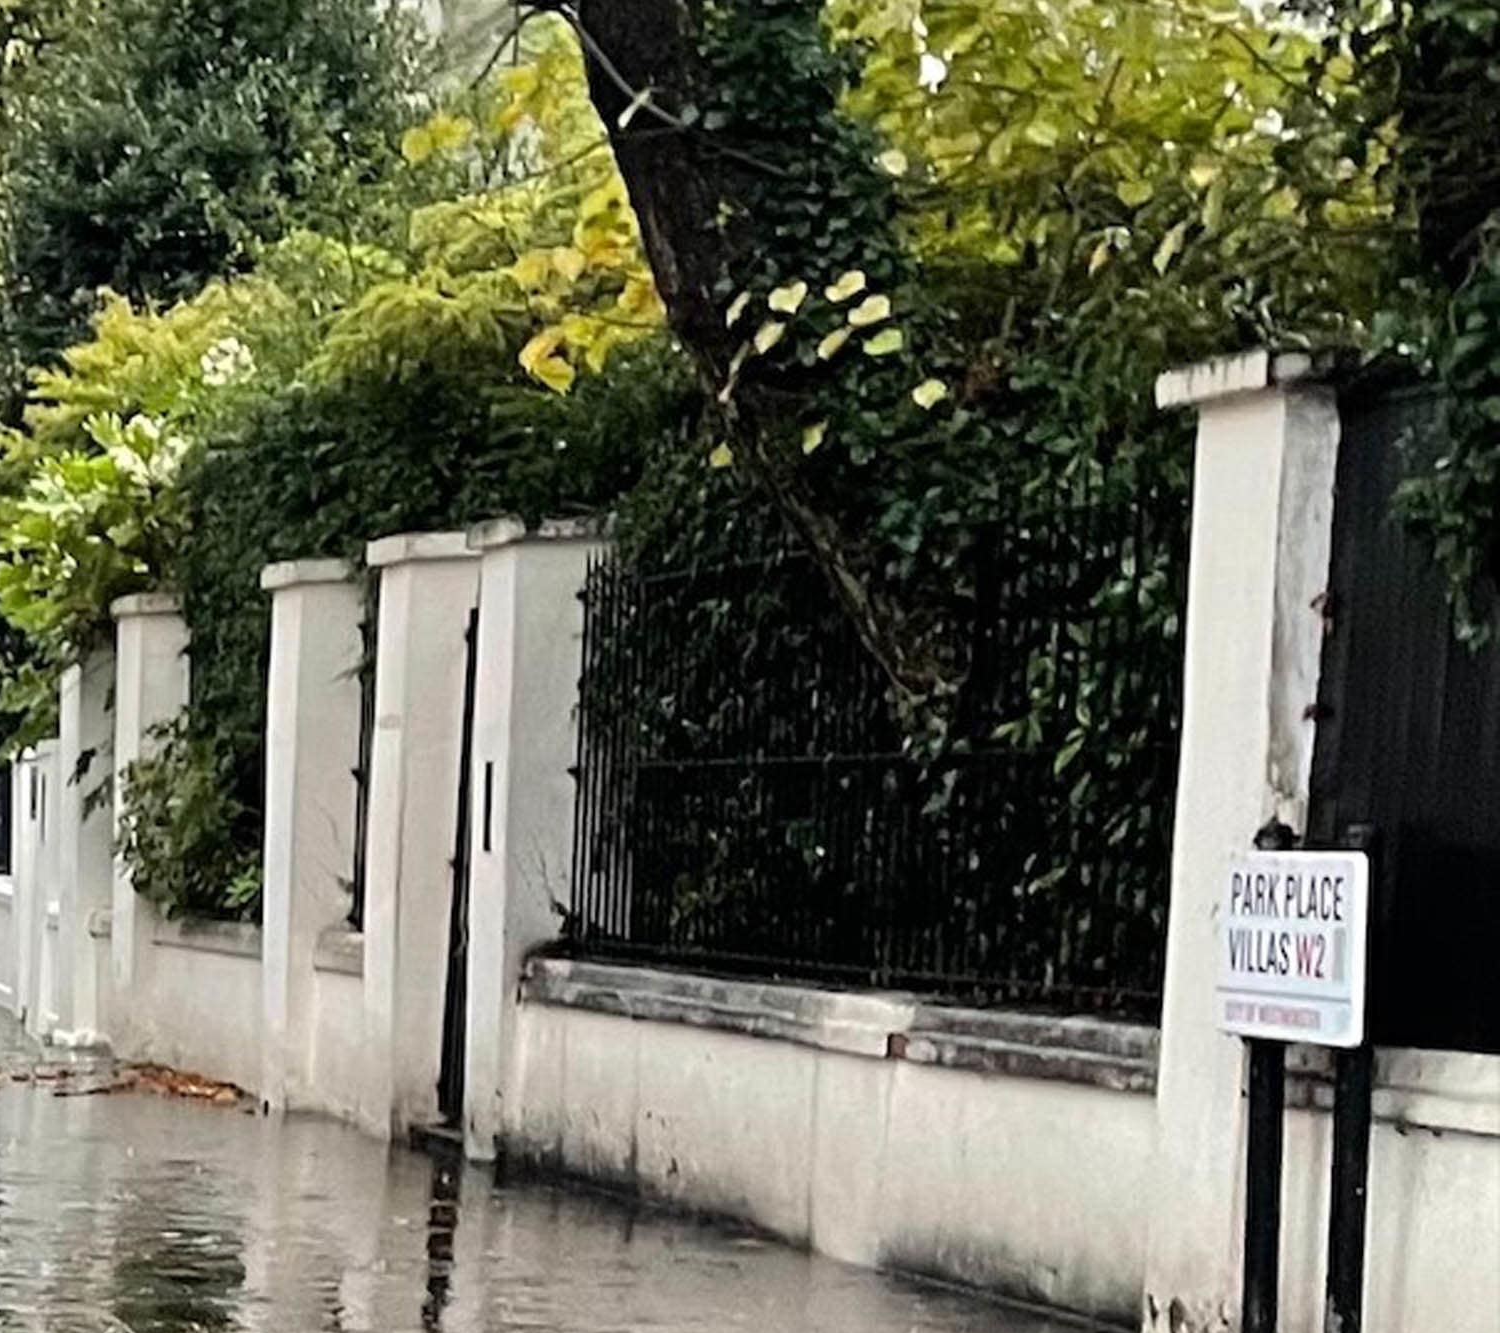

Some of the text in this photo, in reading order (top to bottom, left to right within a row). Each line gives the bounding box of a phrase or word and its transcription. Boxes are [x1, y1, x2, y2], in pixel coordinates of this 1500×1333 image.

[1231, 871, 1345, 921] PARK PLACE
[1228, 928, 1327, 979] VILLAS W2
